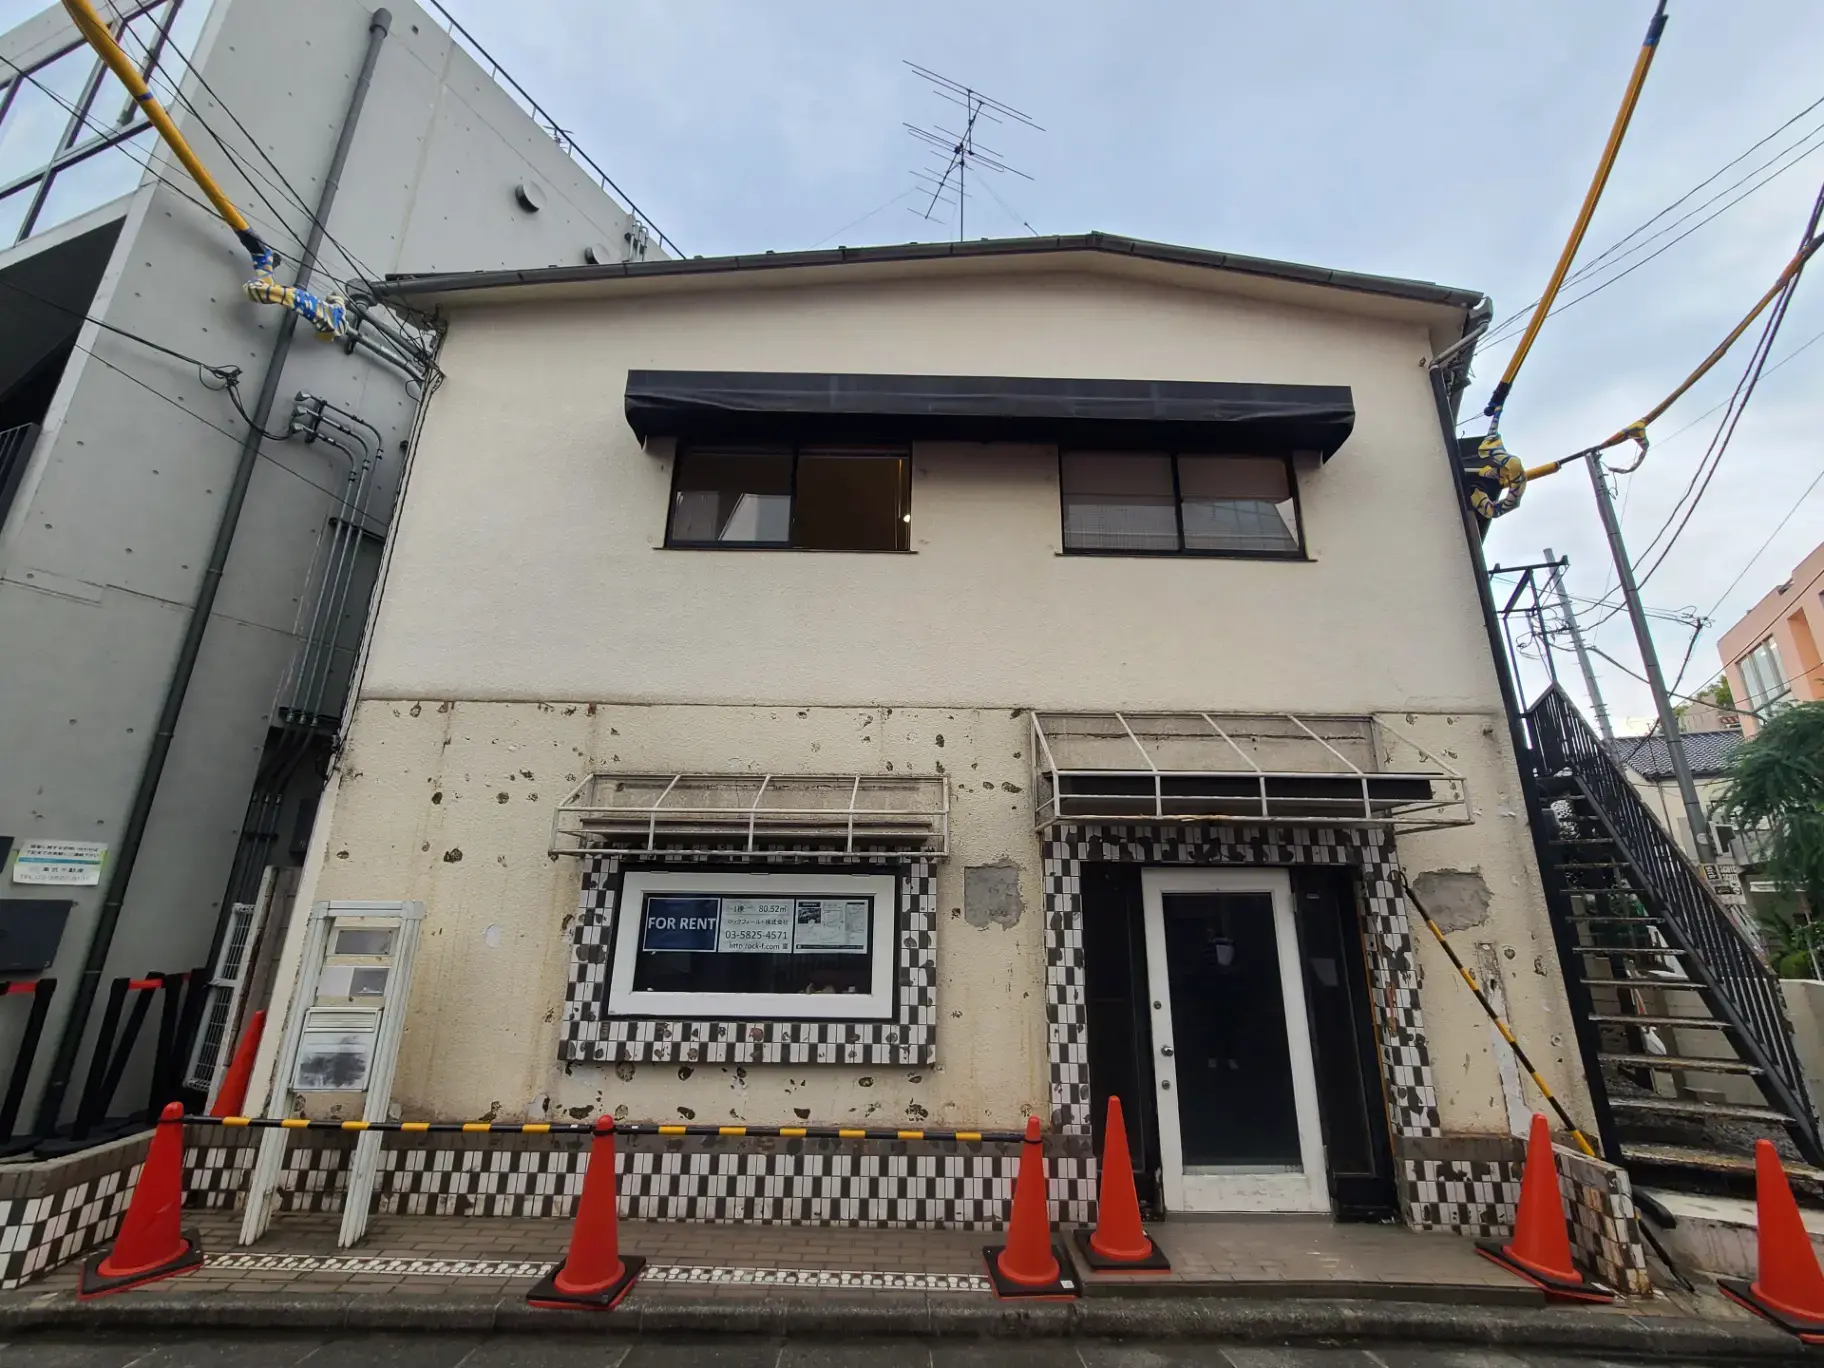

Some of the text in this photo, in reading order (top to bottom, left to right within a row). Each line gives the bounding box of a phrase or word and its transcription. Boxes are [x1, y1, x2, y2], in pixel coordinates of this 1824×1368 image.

[648, 917, 717, 930] FOR RENT
[725, 930, 788, 940] 03-5825-4571
